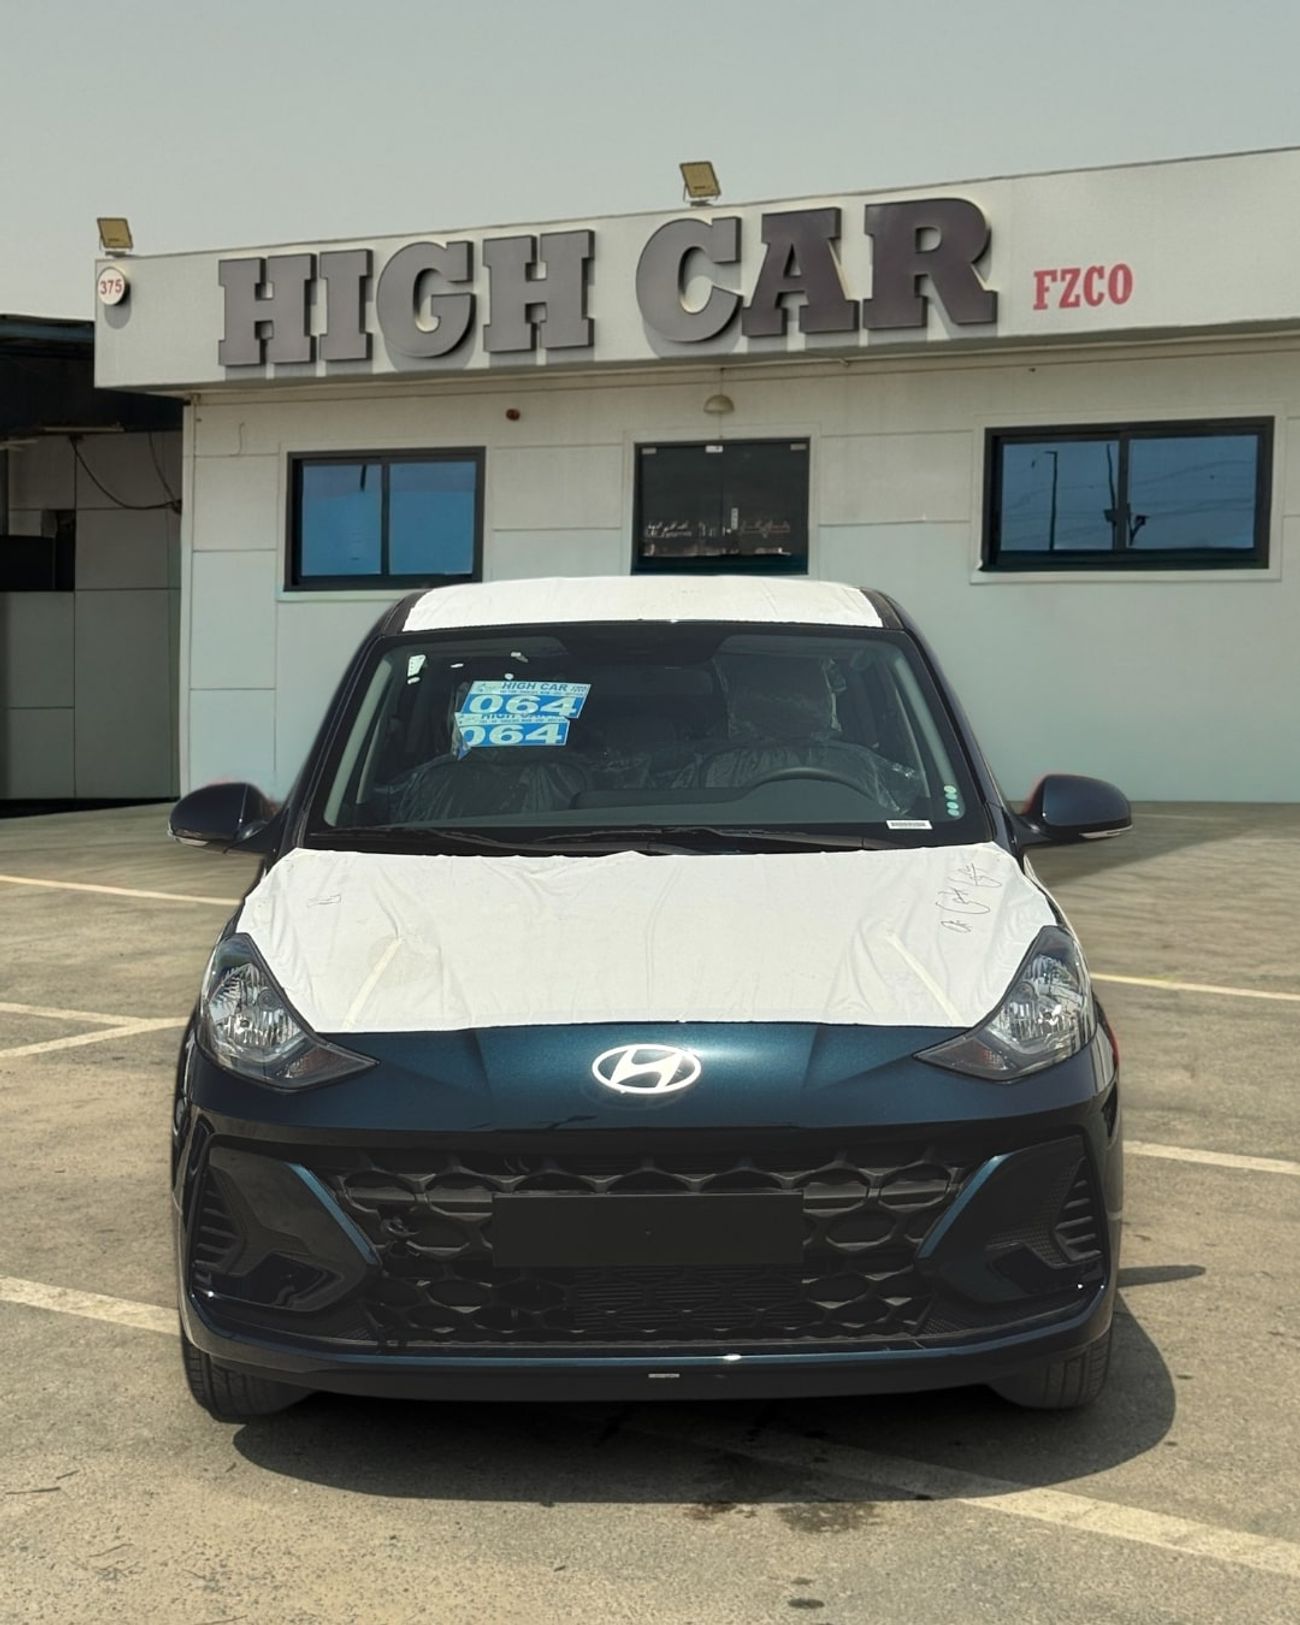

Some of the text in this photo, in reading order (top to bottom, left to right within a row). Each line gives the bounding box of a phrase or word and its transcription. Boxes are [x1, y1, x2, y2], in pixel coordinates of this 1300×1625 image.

[100, 279, 122, 295] 375
[218, 197, 1133, 367] HIGH CAR FZCO
[502, 682, 536, 690] HIGH
[540, 683, 568, 691] CAR
[469, 694, 577, 716] 064
[460, 724, 562, 744] 064
